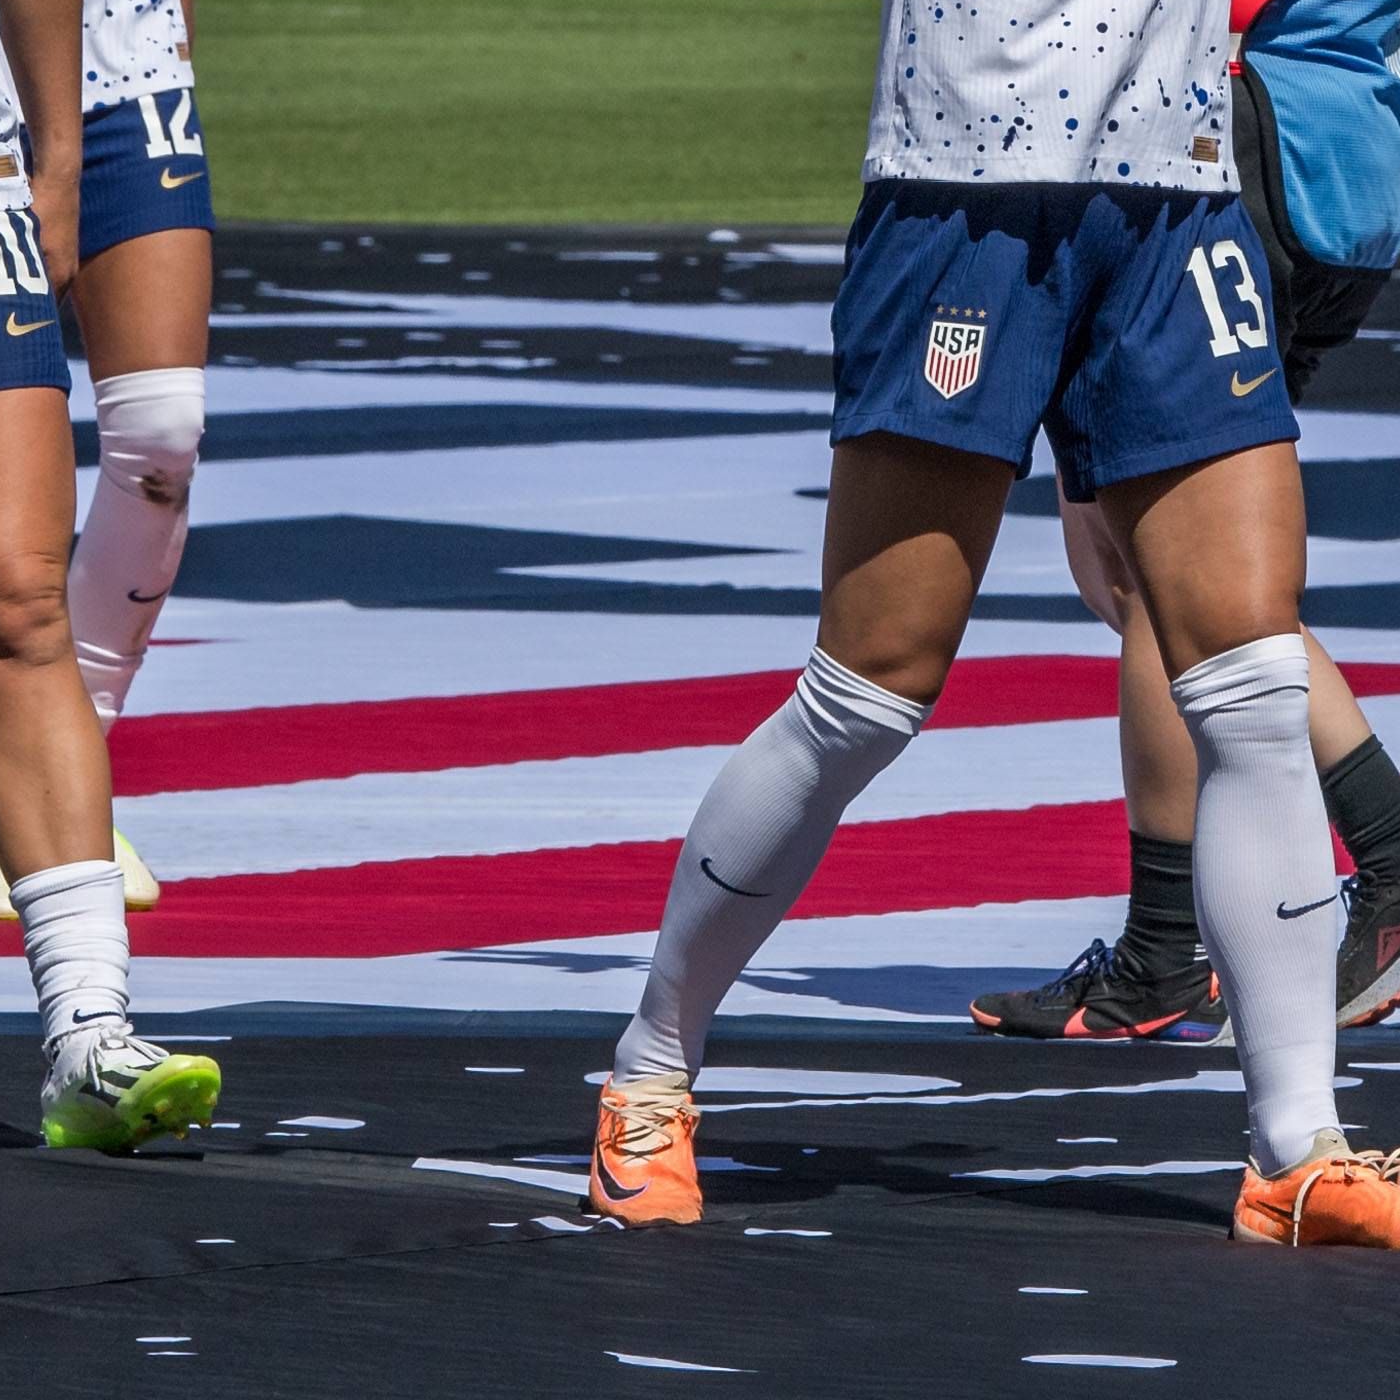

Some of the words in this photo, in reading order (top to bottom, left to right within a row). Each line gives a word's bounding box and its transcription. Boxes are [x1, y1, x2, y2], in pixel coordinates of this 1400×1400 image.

[138, 88, 203, 158] 12
[1186, 239, 1268, 358] 13
[934, 325, 980, 355] USA
